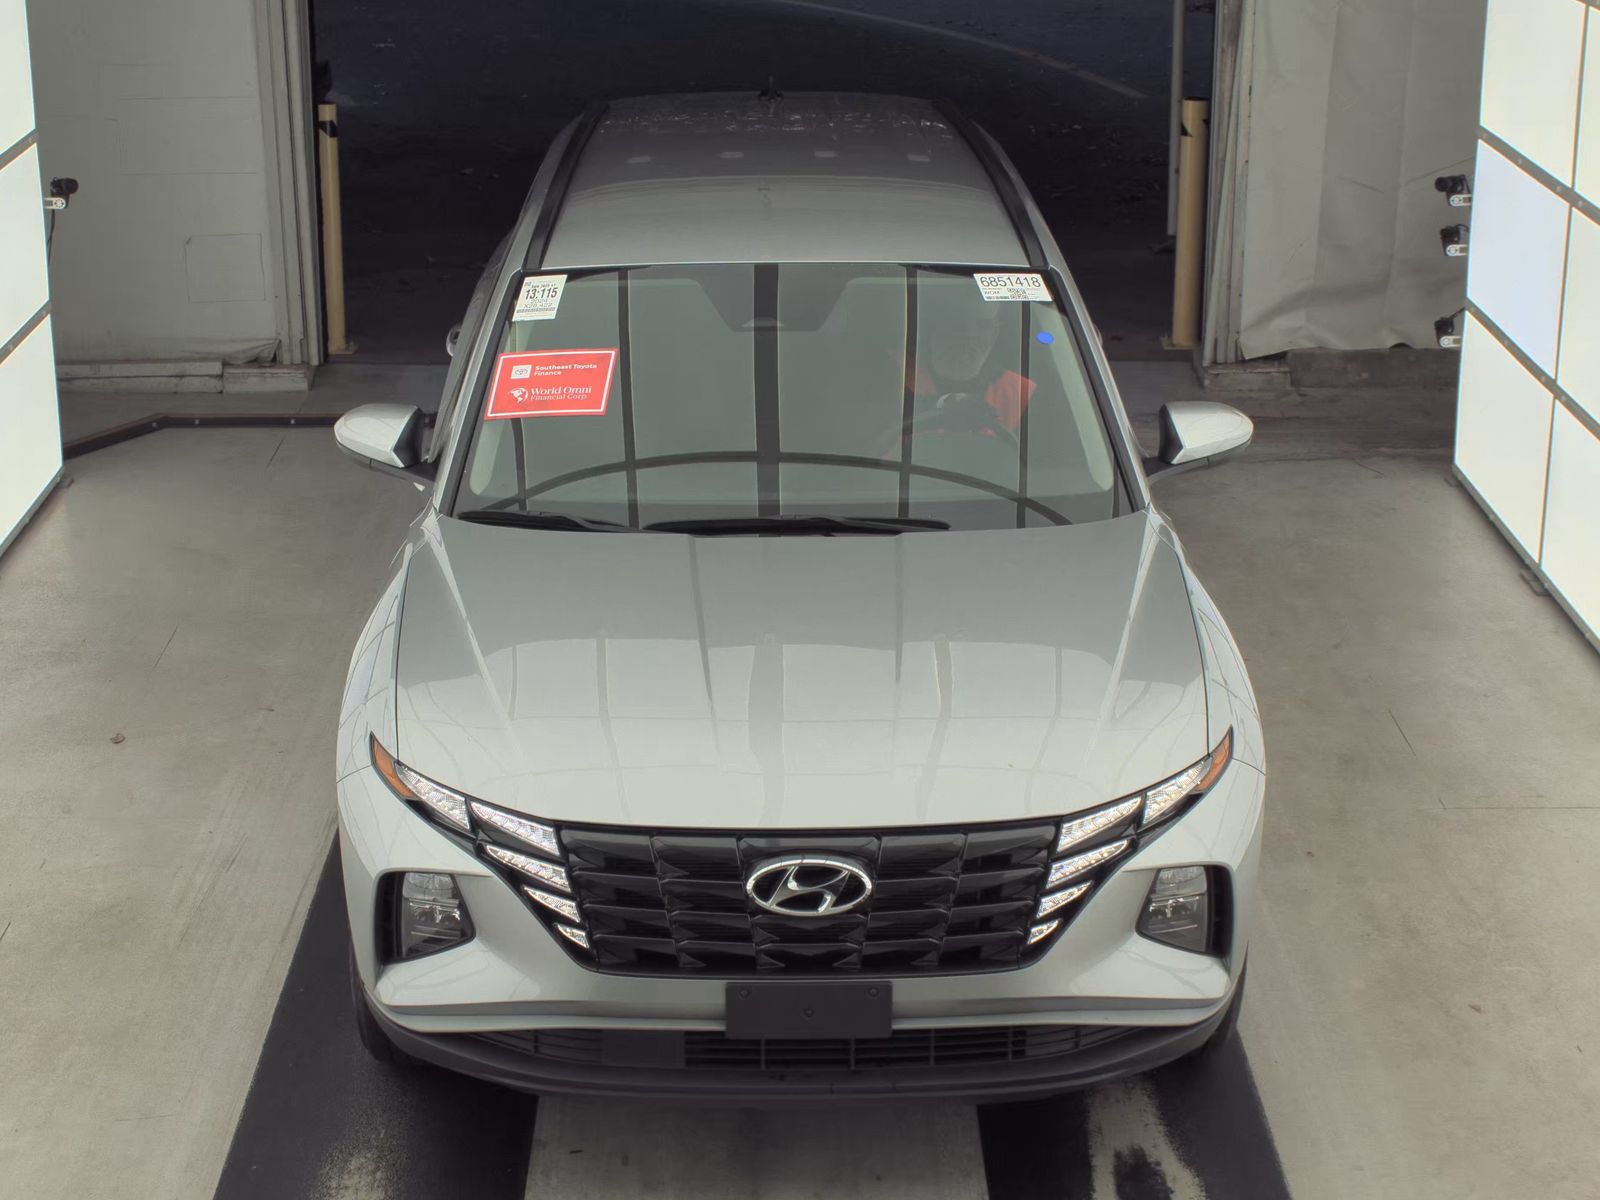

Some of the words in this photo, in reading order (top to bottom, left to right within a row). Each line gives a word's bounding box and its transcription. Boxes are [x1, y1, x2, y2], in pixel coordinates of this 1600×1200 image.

[980, 276, 1041, 287] 6851418
[525, 287, 558, 300] 13:115
[531, 386, 562, 396] World
[563, 386, 592, 394] Omni
